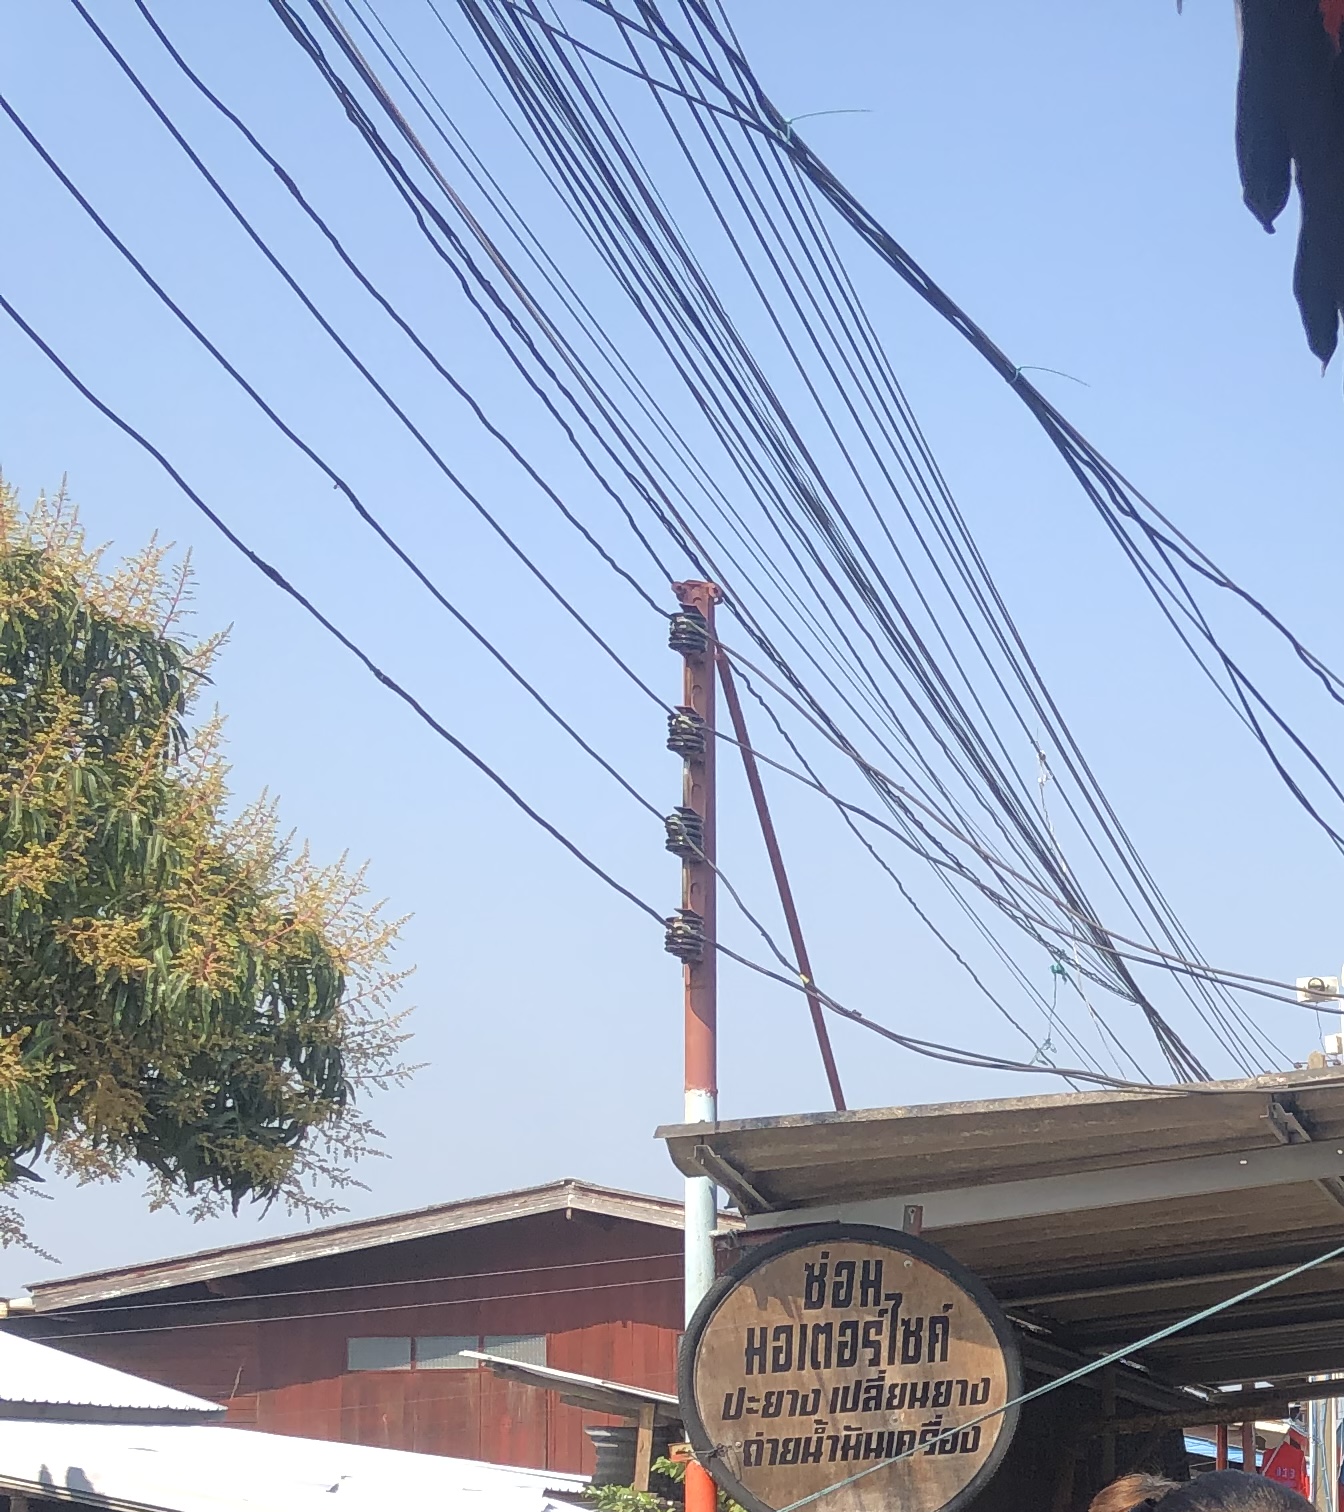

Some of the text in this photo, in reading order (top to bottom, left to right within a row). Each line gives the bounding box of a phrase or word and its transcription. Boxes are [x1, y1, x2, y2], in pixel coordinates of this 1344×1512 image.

[804, 1251, 884, 1311] ซ่อม
[721, 1369, 991, 1421] ปะยาง เปลี่ยนยาง
[742, 1414, 982, 1467] ถ่ายน้ำมันเครื่อง
